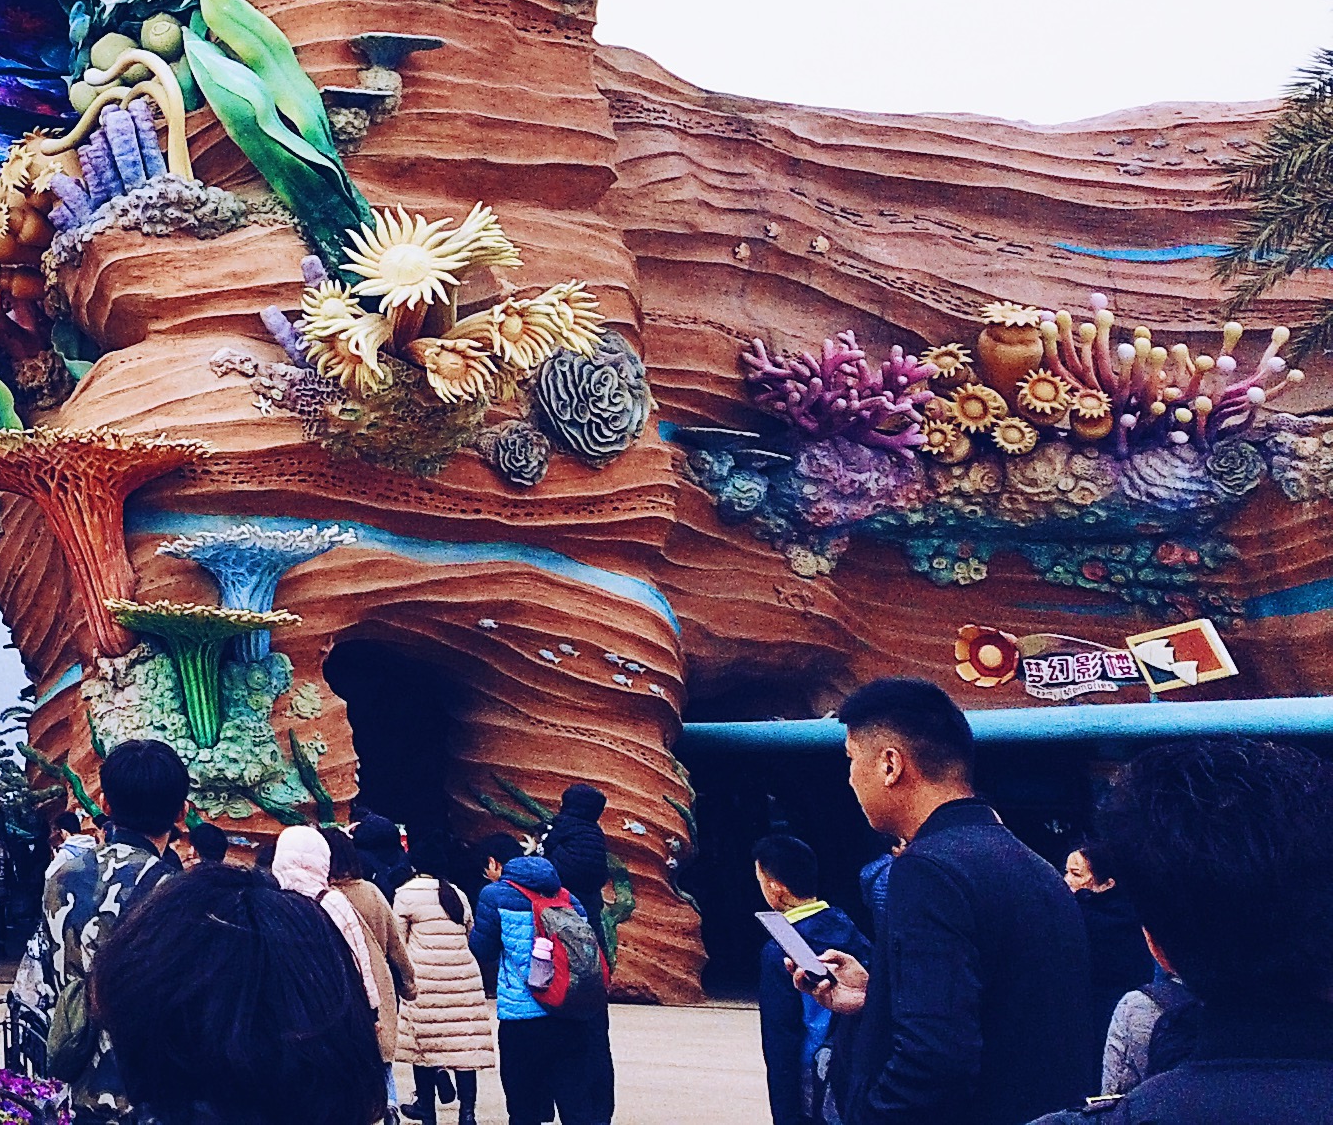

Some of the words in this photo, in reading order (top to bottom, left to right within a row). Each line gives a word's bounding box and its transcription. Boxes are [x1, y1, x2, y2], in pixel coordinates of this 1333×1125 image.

[1024, 652, 1137, 683] 梦幻影楼
[1063, 681, 1113, 696] Memories
